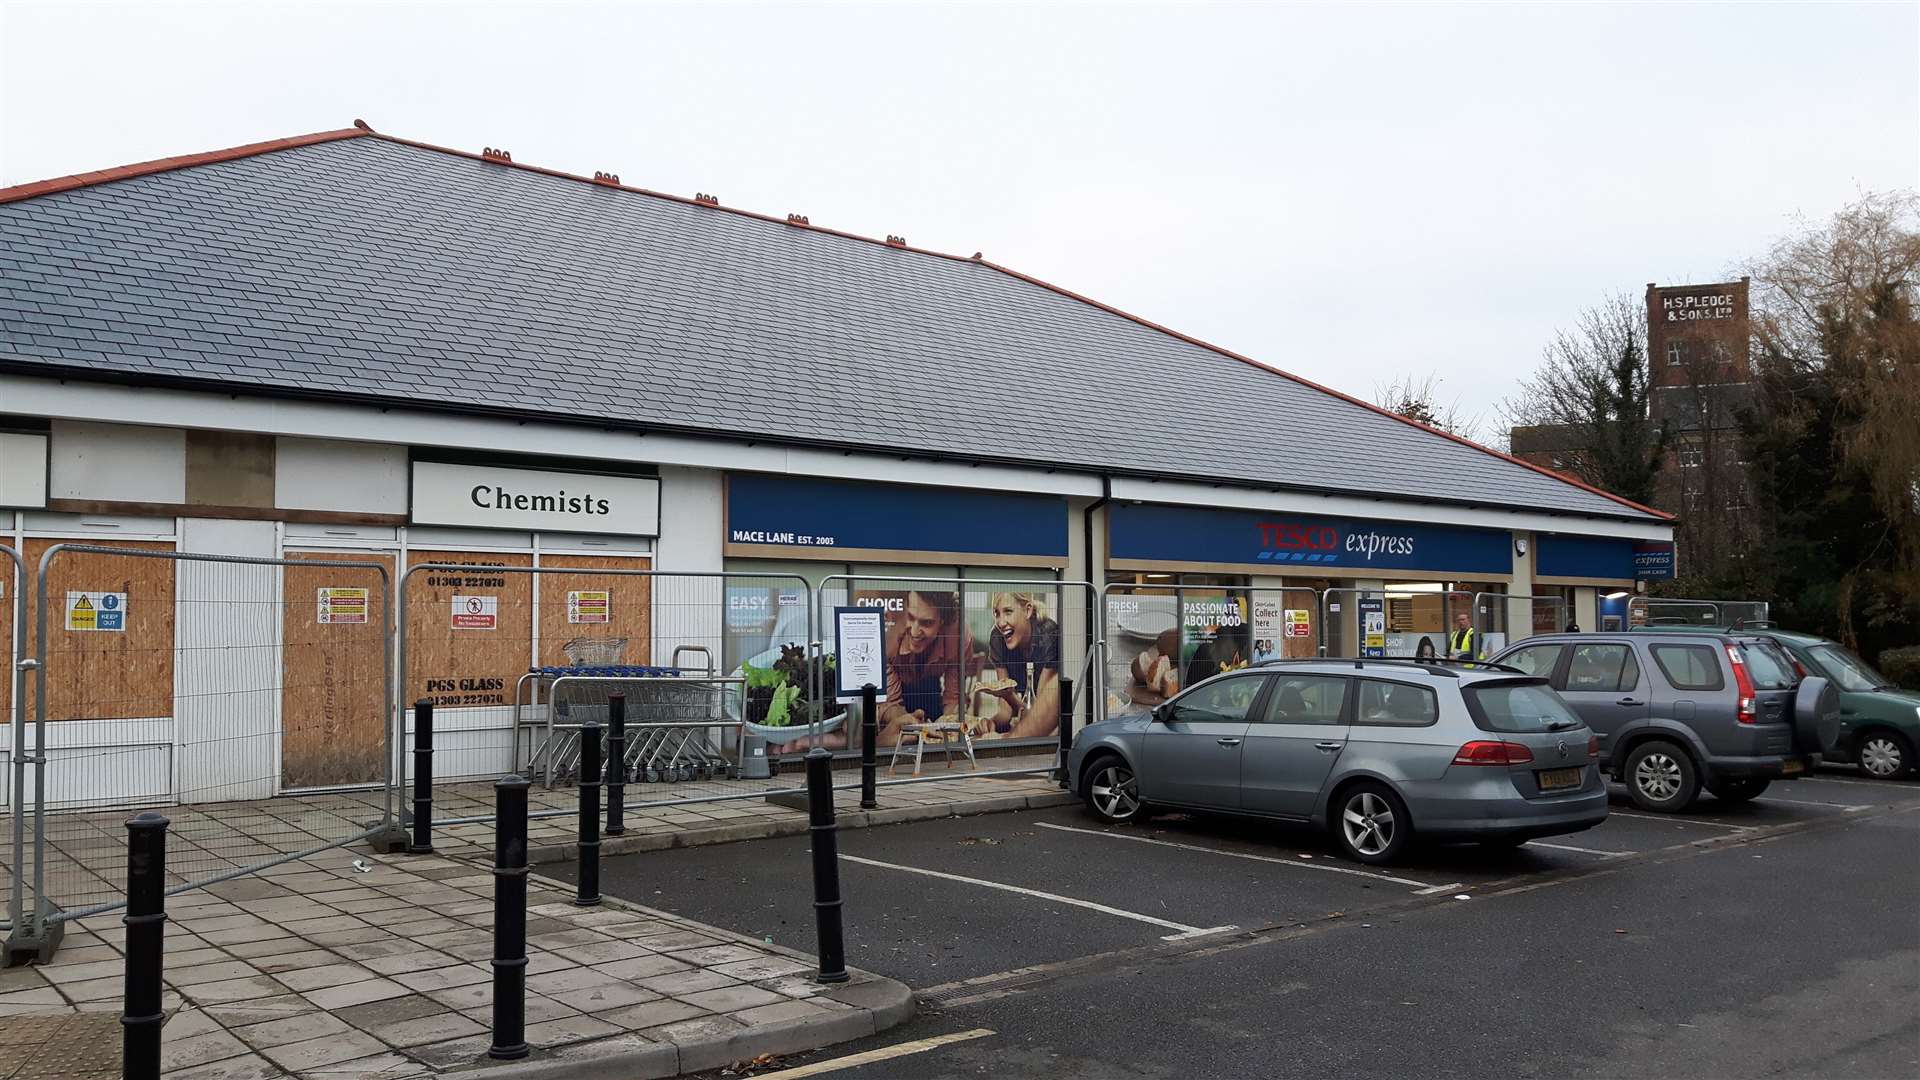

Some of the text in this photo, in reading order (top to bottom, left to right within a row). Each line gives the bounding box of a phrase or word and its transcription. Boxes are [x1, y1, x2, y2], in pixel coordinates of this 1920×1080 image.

[1668, 311, 1678, 321] &
[471, 485, 610, 515] Chemists
[733, 530, 834, 545] MACE LANE EST. 2003
[1256, 522, 1414, 560] TESCO express
[1635, 556, 1670, 566] express
[428, 576, 504, 588] 01303 227070
[730, 596, 768, 610] EASY
[857, 598, 904, 611] CHOICE
[1108, 601, 1138, 613] FRESH
[1183, 603, 1239, 615] PASSIONATE
[1255, 608, 1278, 618] Collect
[1183, 615, 1241, 627] ABOUT FOOD
[1255, 619, 1270, 627] here
[427, 678, 504, 692] PGS GLASS
[463, 694, 503, 705] 227070
